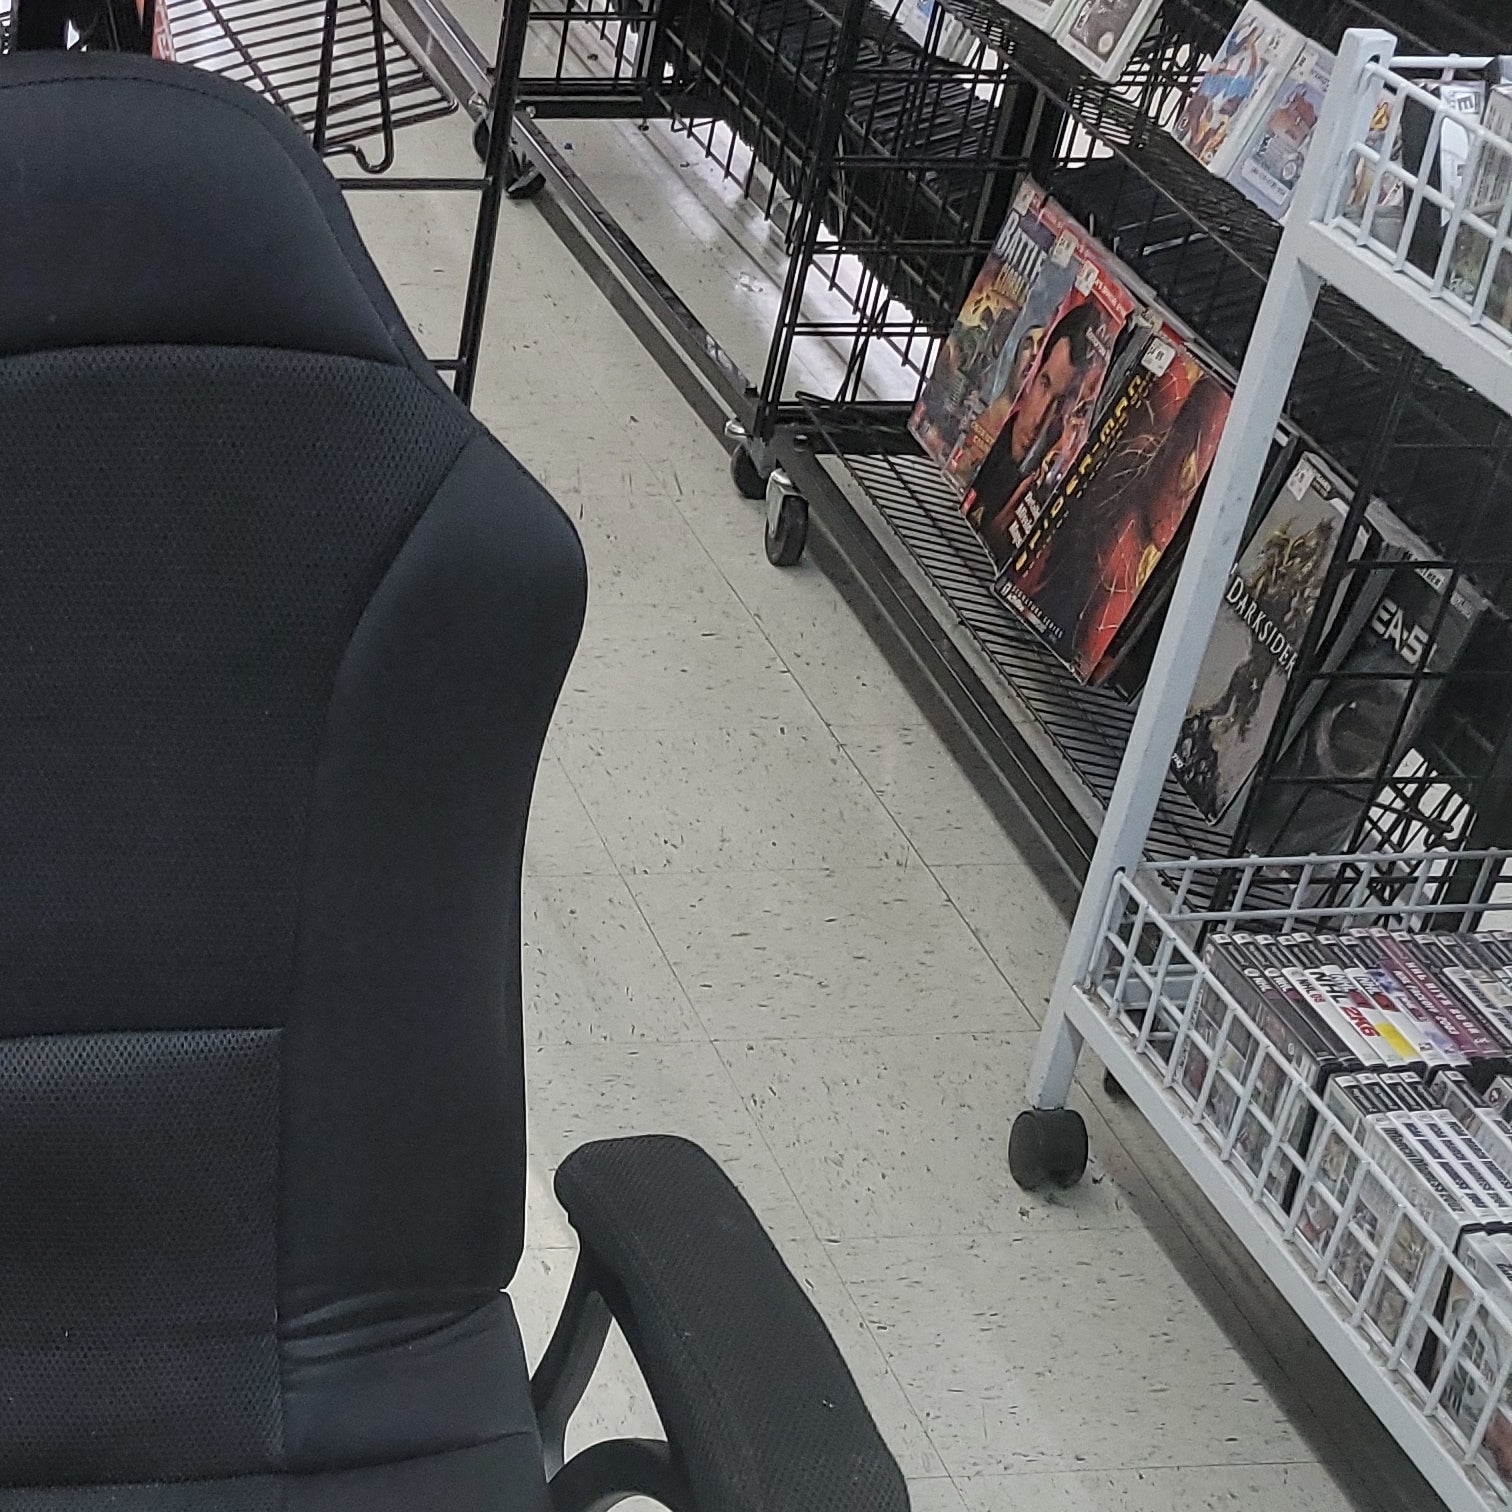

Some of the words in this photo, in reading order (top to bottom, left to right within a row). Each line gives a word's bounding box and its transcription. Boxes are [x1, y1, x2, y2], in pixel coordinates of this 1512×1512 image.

[993, 210, 1048, 283] BATTLE
[1224, 575, 1298, 680] DARKSIDER
[1252, 975, 1271, 993] NHL
[1273, 974, 1292, 993] NHL
[1309, 970, 1346, 1004] NHL
[1340, 1005, 1381, 1040] 2K6
